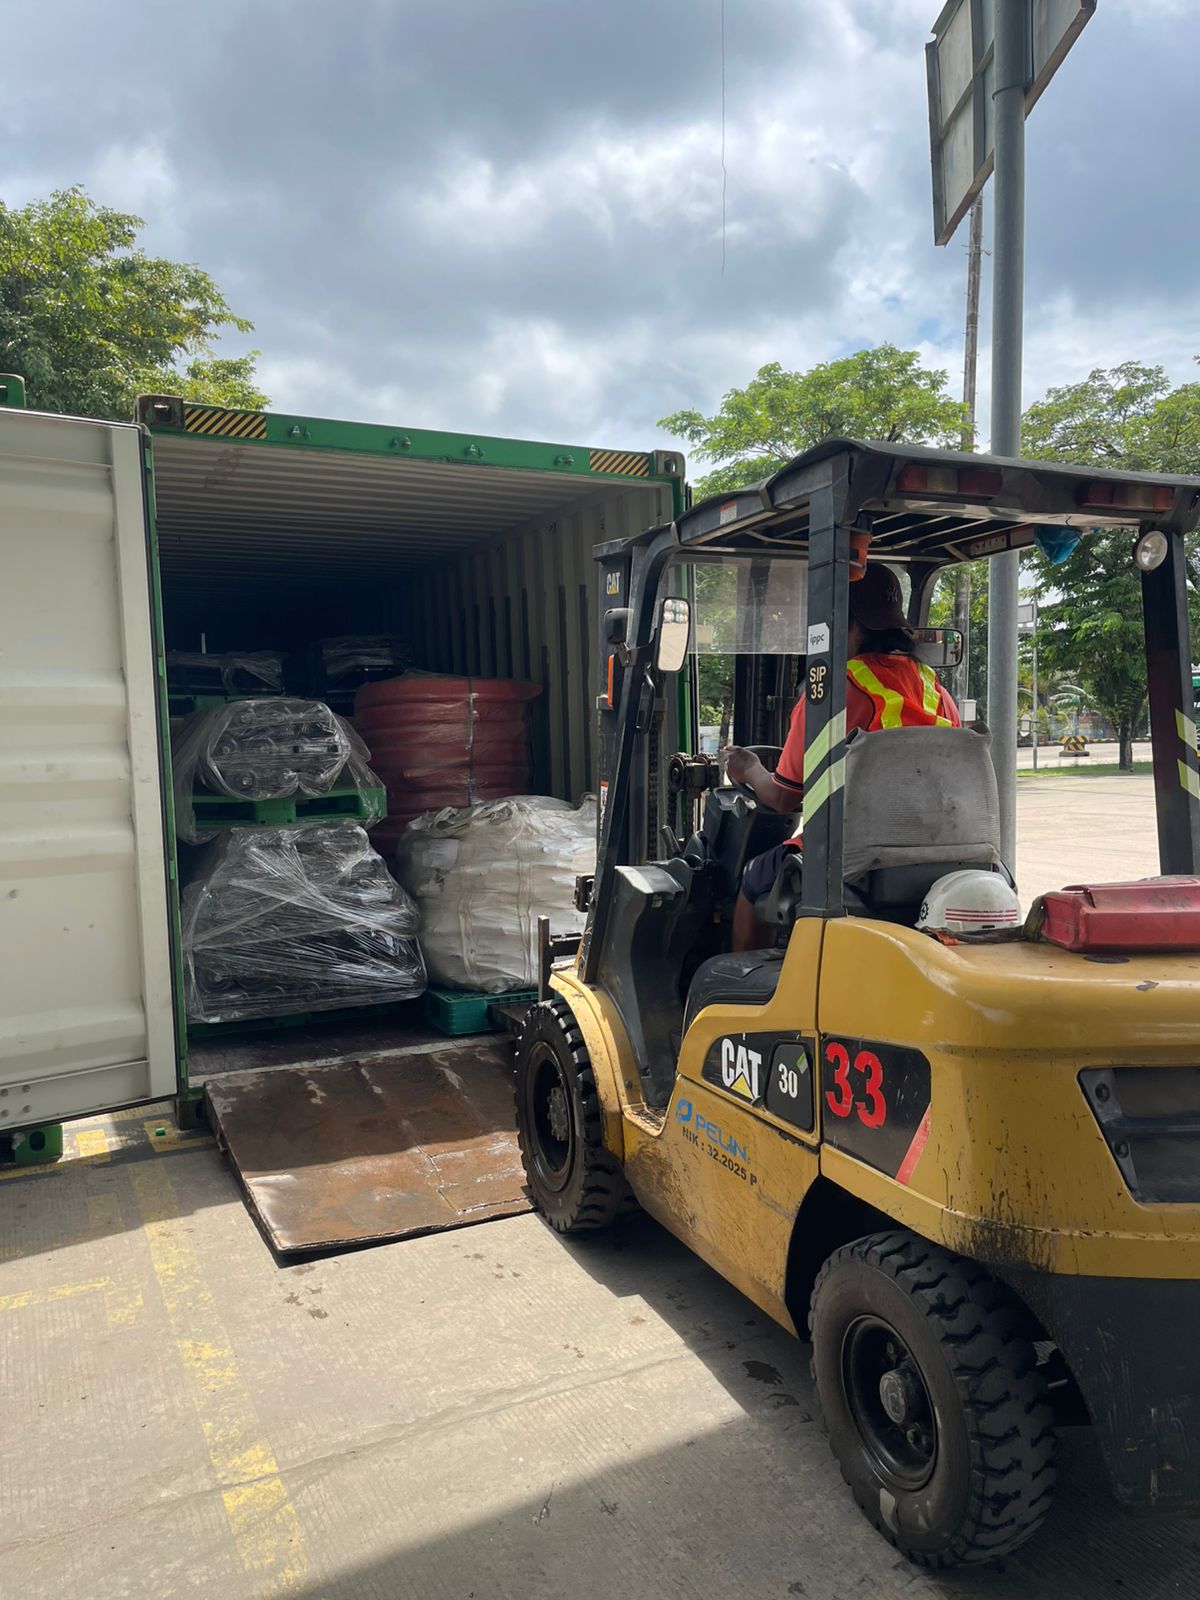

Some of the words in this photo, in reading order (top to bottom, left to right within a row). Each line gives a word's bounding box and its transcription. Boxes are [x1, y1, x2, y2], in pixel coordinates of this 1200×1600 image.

[606, 571, 621, 595] CAT
[809, 665, 827, 683] SIP
[810, 682, 824, 700] 35
[721, 1038, 762, 1100] CAT
[777, 1062, 799, 1099] 30
[824, 1041, 887, 1130] 33
[706, 1143, 748, 1181] 32.2025
